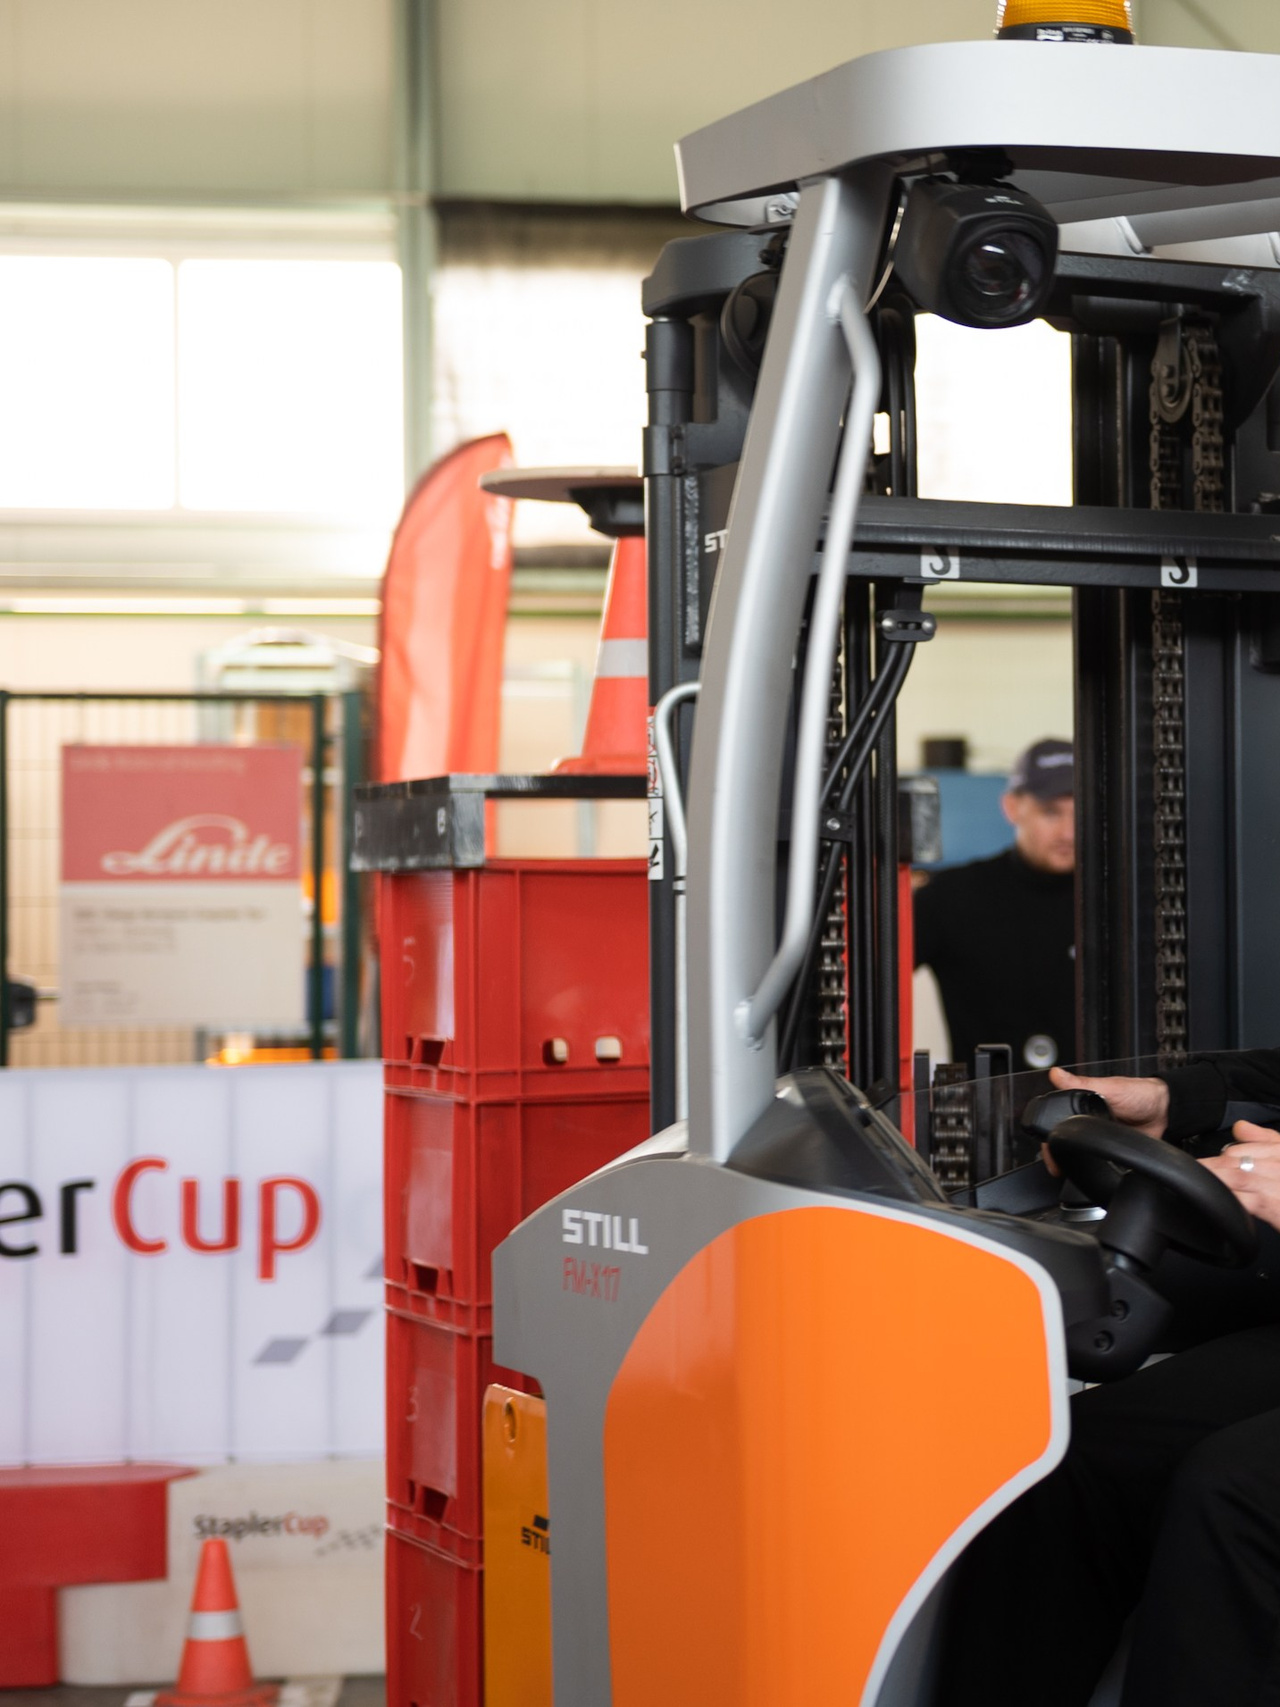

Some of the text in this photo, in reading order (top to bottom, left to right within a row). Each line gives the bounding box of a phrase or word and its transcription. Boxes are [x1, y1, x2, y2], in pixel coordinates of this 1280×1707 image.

[101, 813, 293, 875] Linde
[0, 1157, 322, 1281] erCup
[562, 1208, 649, 1255] STILL
